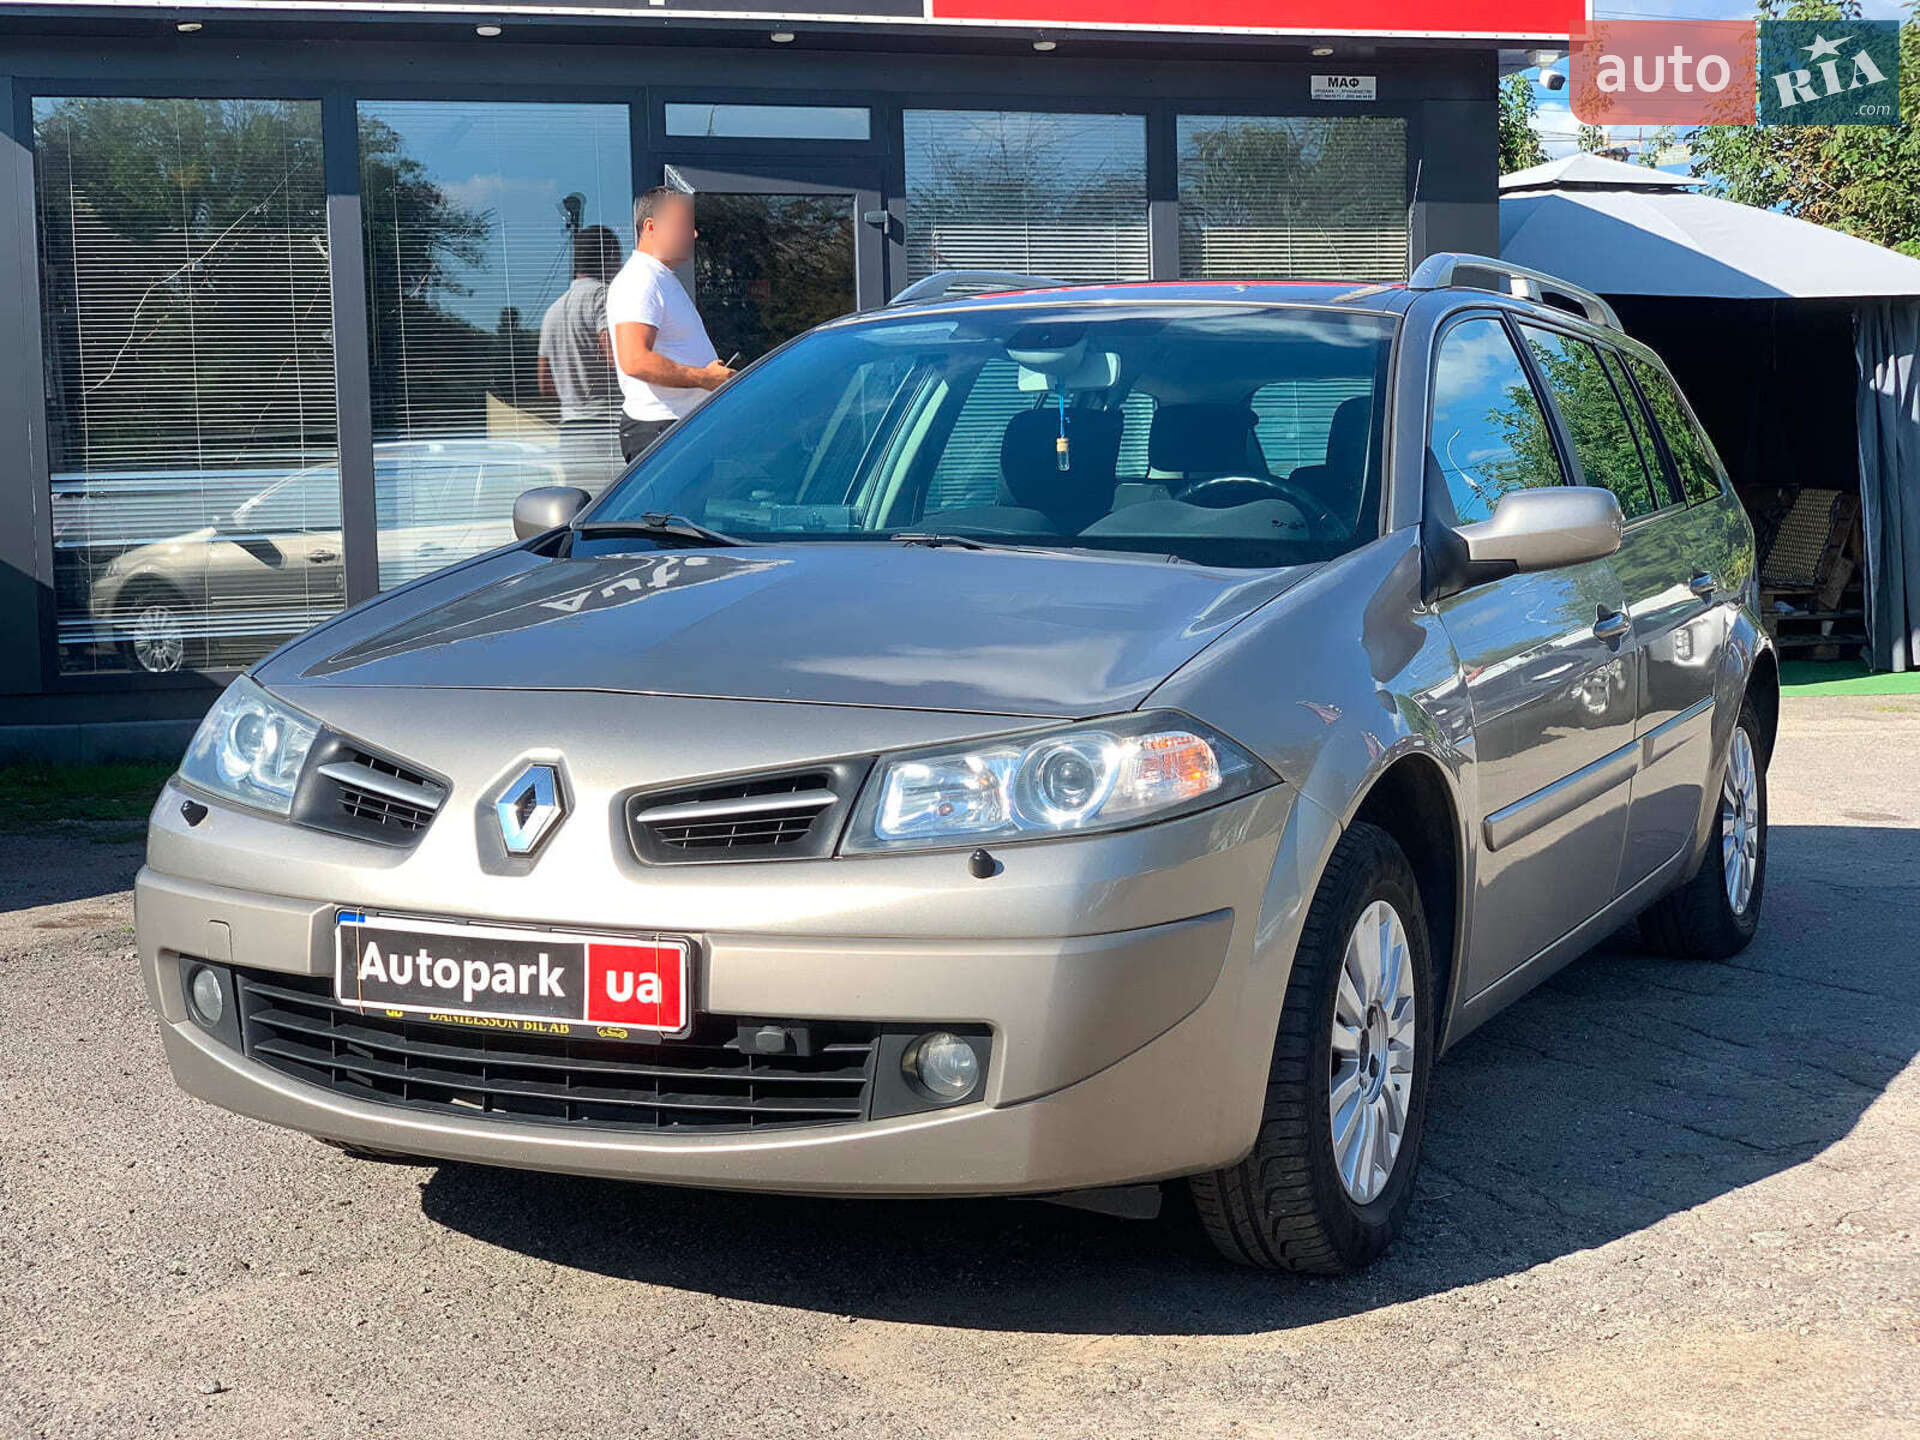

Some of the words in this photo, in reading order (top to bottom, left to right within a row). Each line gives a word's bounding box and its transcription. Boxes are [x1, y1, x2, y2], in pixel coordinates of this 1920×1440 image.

[1328, 77, 1359, 88] МАФ
[359, 941, 566, 1002] Autopark
[606, 969, 662, 1003] ua
[549, 1023, 570, 1034] AB
